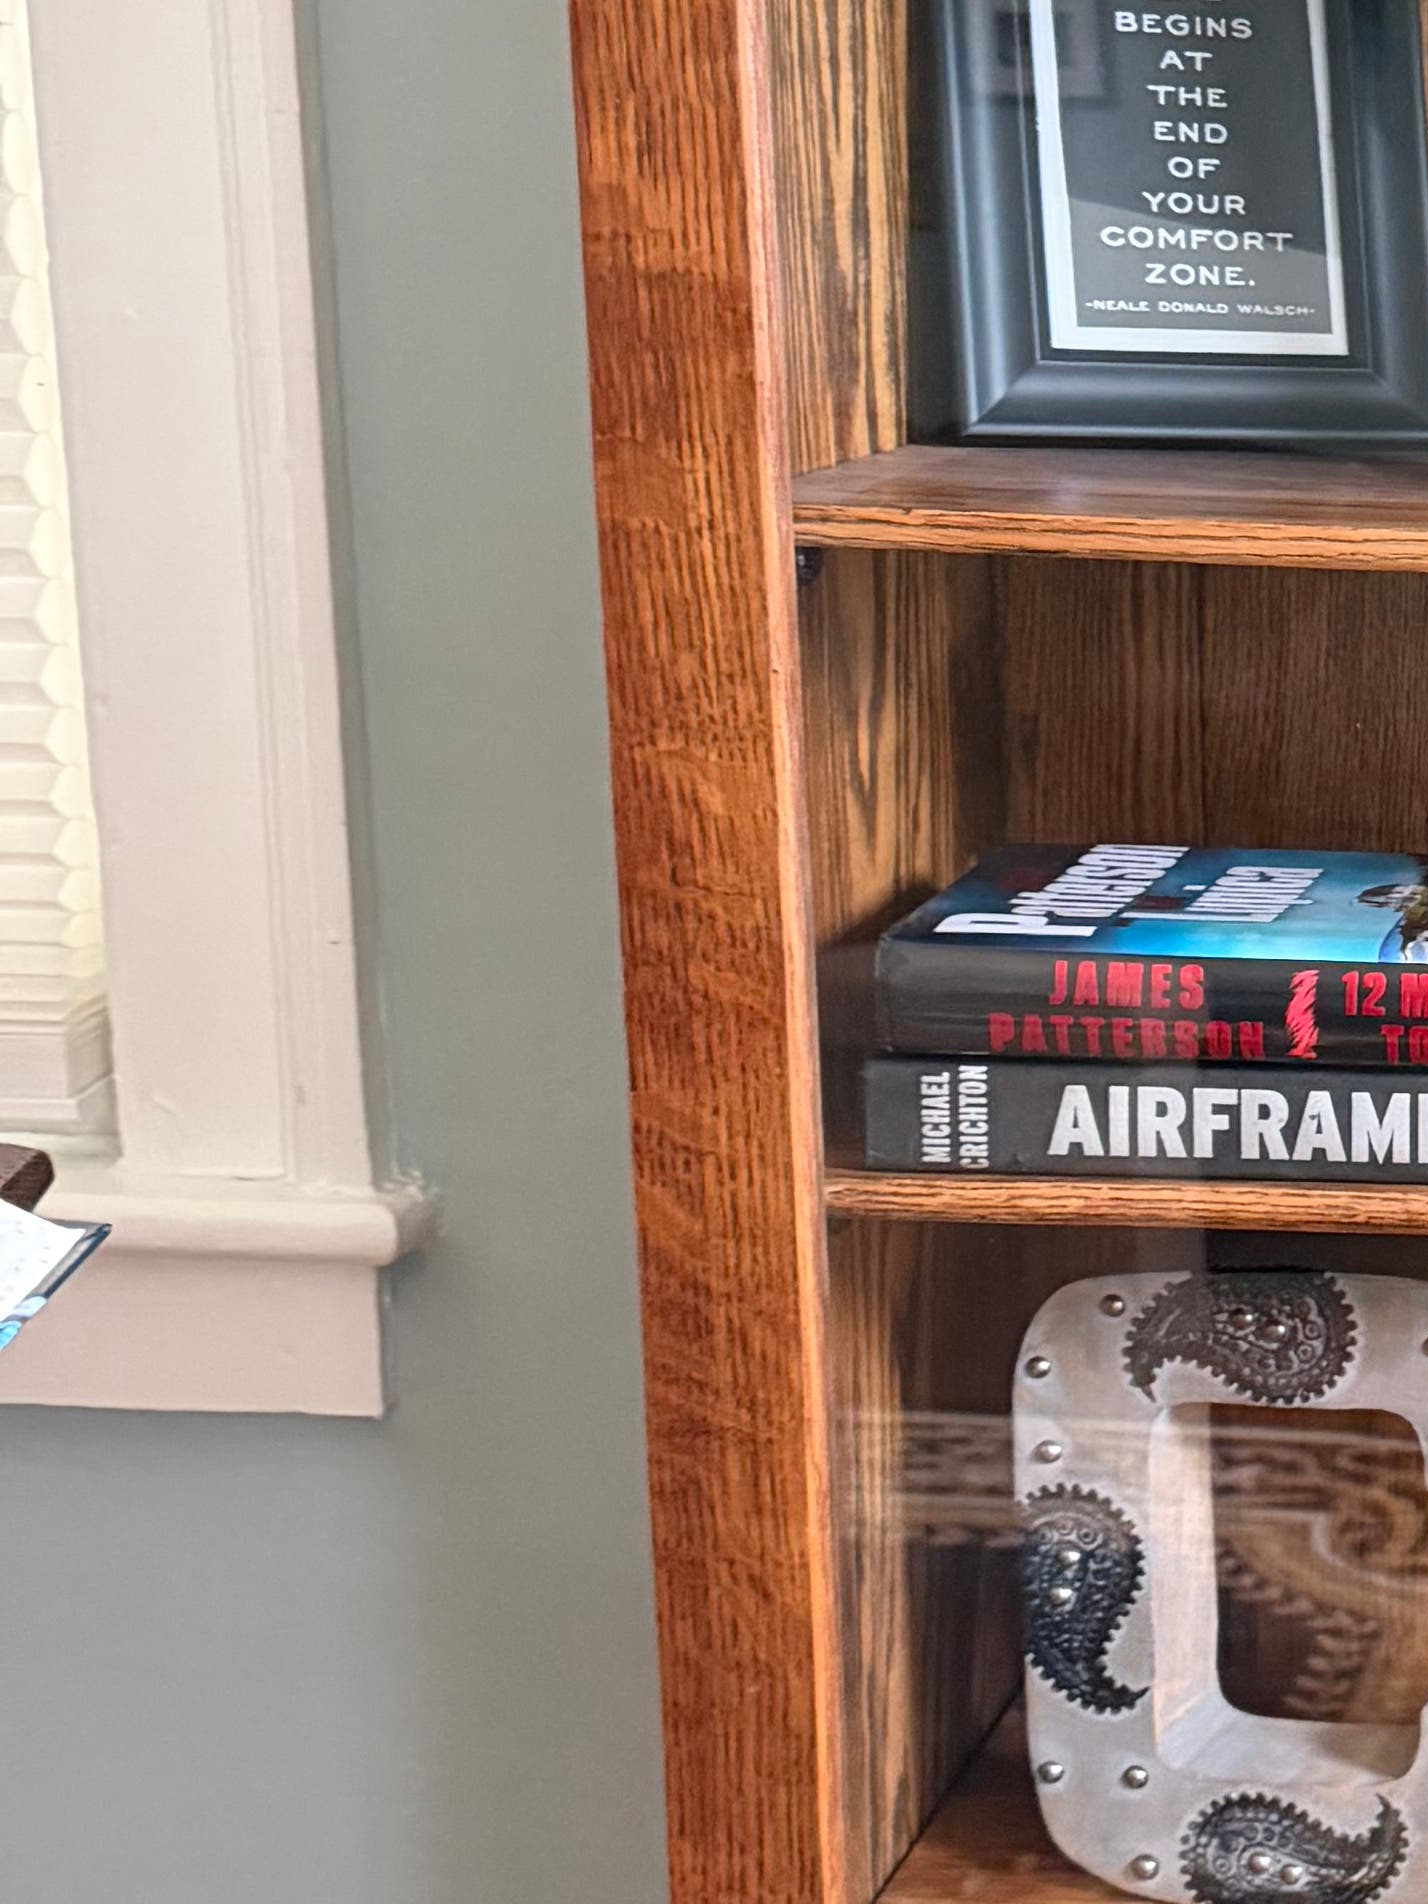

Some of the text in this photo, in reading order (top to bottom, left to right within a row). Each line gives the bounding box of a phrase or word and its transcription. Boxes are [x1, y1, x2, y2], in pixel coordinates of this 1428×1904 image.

[1114, 10, 1253, 39] BEGINS
[1159, 50, 1213, 72] AT
[1147, 84, 1228, 108] THE
[1153, 121, 1228, 144] END
[1167, 156, 1221, 179] OF
[1142, 191, 1246, 216] YOUR
[1100, 226, 1294, 252] COMFORT
[1145, 263, 1255, 287] ZONE.
[1158, 301, 1229, 314] DONALD
[1048, 959, 1206, 1011] JAMES
[1342, 969, 1387, 1017] 12
[988, 1012, 1264, 1062] PATTERSON
[920, 1070, 952, 1165] MICHAEL
[958, 1064, 989, 1169] CRICHTON
